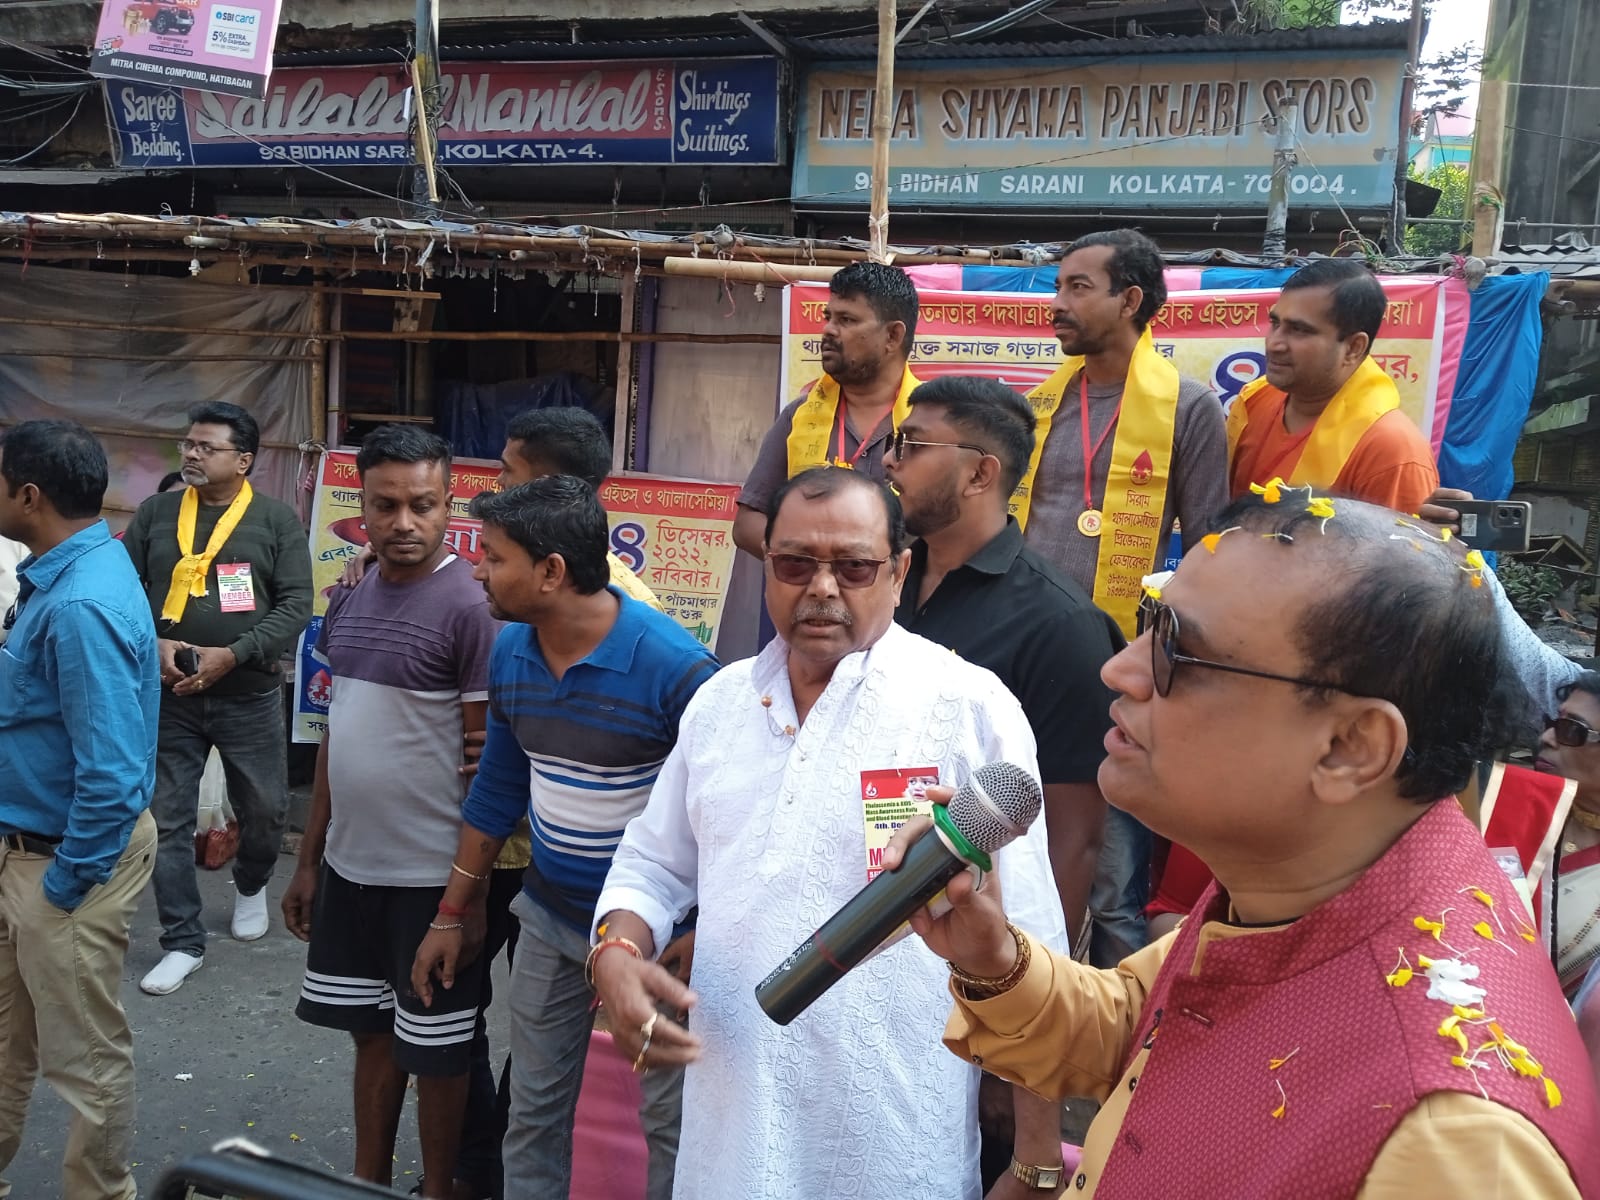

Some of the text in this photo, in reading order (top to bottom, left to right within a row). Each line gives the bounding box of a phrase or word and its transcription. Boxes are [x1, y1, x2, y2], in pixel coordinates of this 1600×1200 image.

[222, 12, 255, 24] SBI card
[212, 31, 227, 43] 5%
[110, 58, 252, 88] MITRA CINEMA COMPOUND, HATIBAGAN
[121, 87, 177, 125] Saree
[450, 69, 651, 133] Manilal
[680, 70, 751, 126] Shirtings
[818, 87, 919, 140] NEA
[940, 85, 1087, 141] SHYAMA
[1101, 81, 1249, 138] PANJABI
[129, 133, 185, 162] Bedding.
[855, 172, 893, 195] 9,
[900, 172, 979, 193] BIDHAN
[1000, 174, 1084, 195] SARANI
[946, 341, 1001, 357] সমাজ
[1006, 341, 1058, 360] গড়ার
[642, 488, 653, 504] ও
[655, 518, 730, 550] ডিসেম্বর,
[318, 545, 357, 562] এবং
[652, 543, 709, 567] ২০২২,
